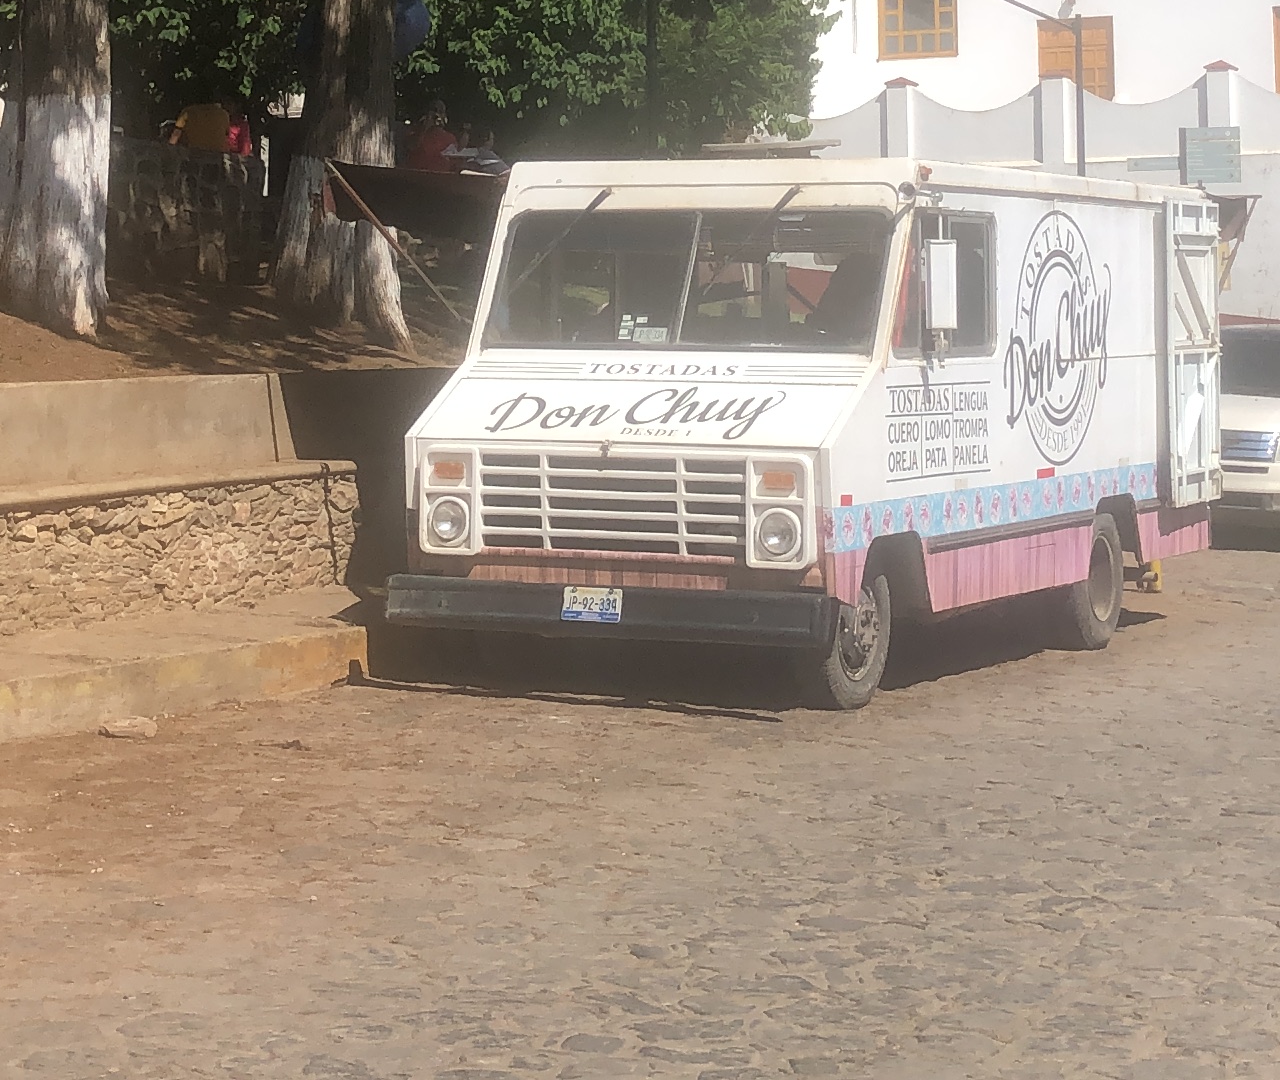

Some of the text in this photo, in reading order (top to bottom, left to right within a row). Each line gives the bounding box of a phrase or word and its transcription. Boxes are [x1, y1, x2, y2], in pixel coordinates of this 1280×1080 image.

[1021, 224, 1091, 320] TOSTADAS
[1004, 263, 1111, 430] Don Chuy
[589, 363, 739, 376] TOSTADAS
[889, 388, 950, 414] TOSTADAS
[953, 391, 989, 412] LENGUA
[484, 386, 787, 440] Don Chuy
[619, 426, 679, 437] DESDE
[887, 421, 920, 445] CUERO
[924, 418, 951, 441] LOMO
[953, 417, 989, 439] TROMPA
[1039, 418, 1069, 453] DESDE
[887, 449, 919, 473] OREJA
[925, 446, 948, 469] PATA
[953, 444, 989, 466] PANELA
